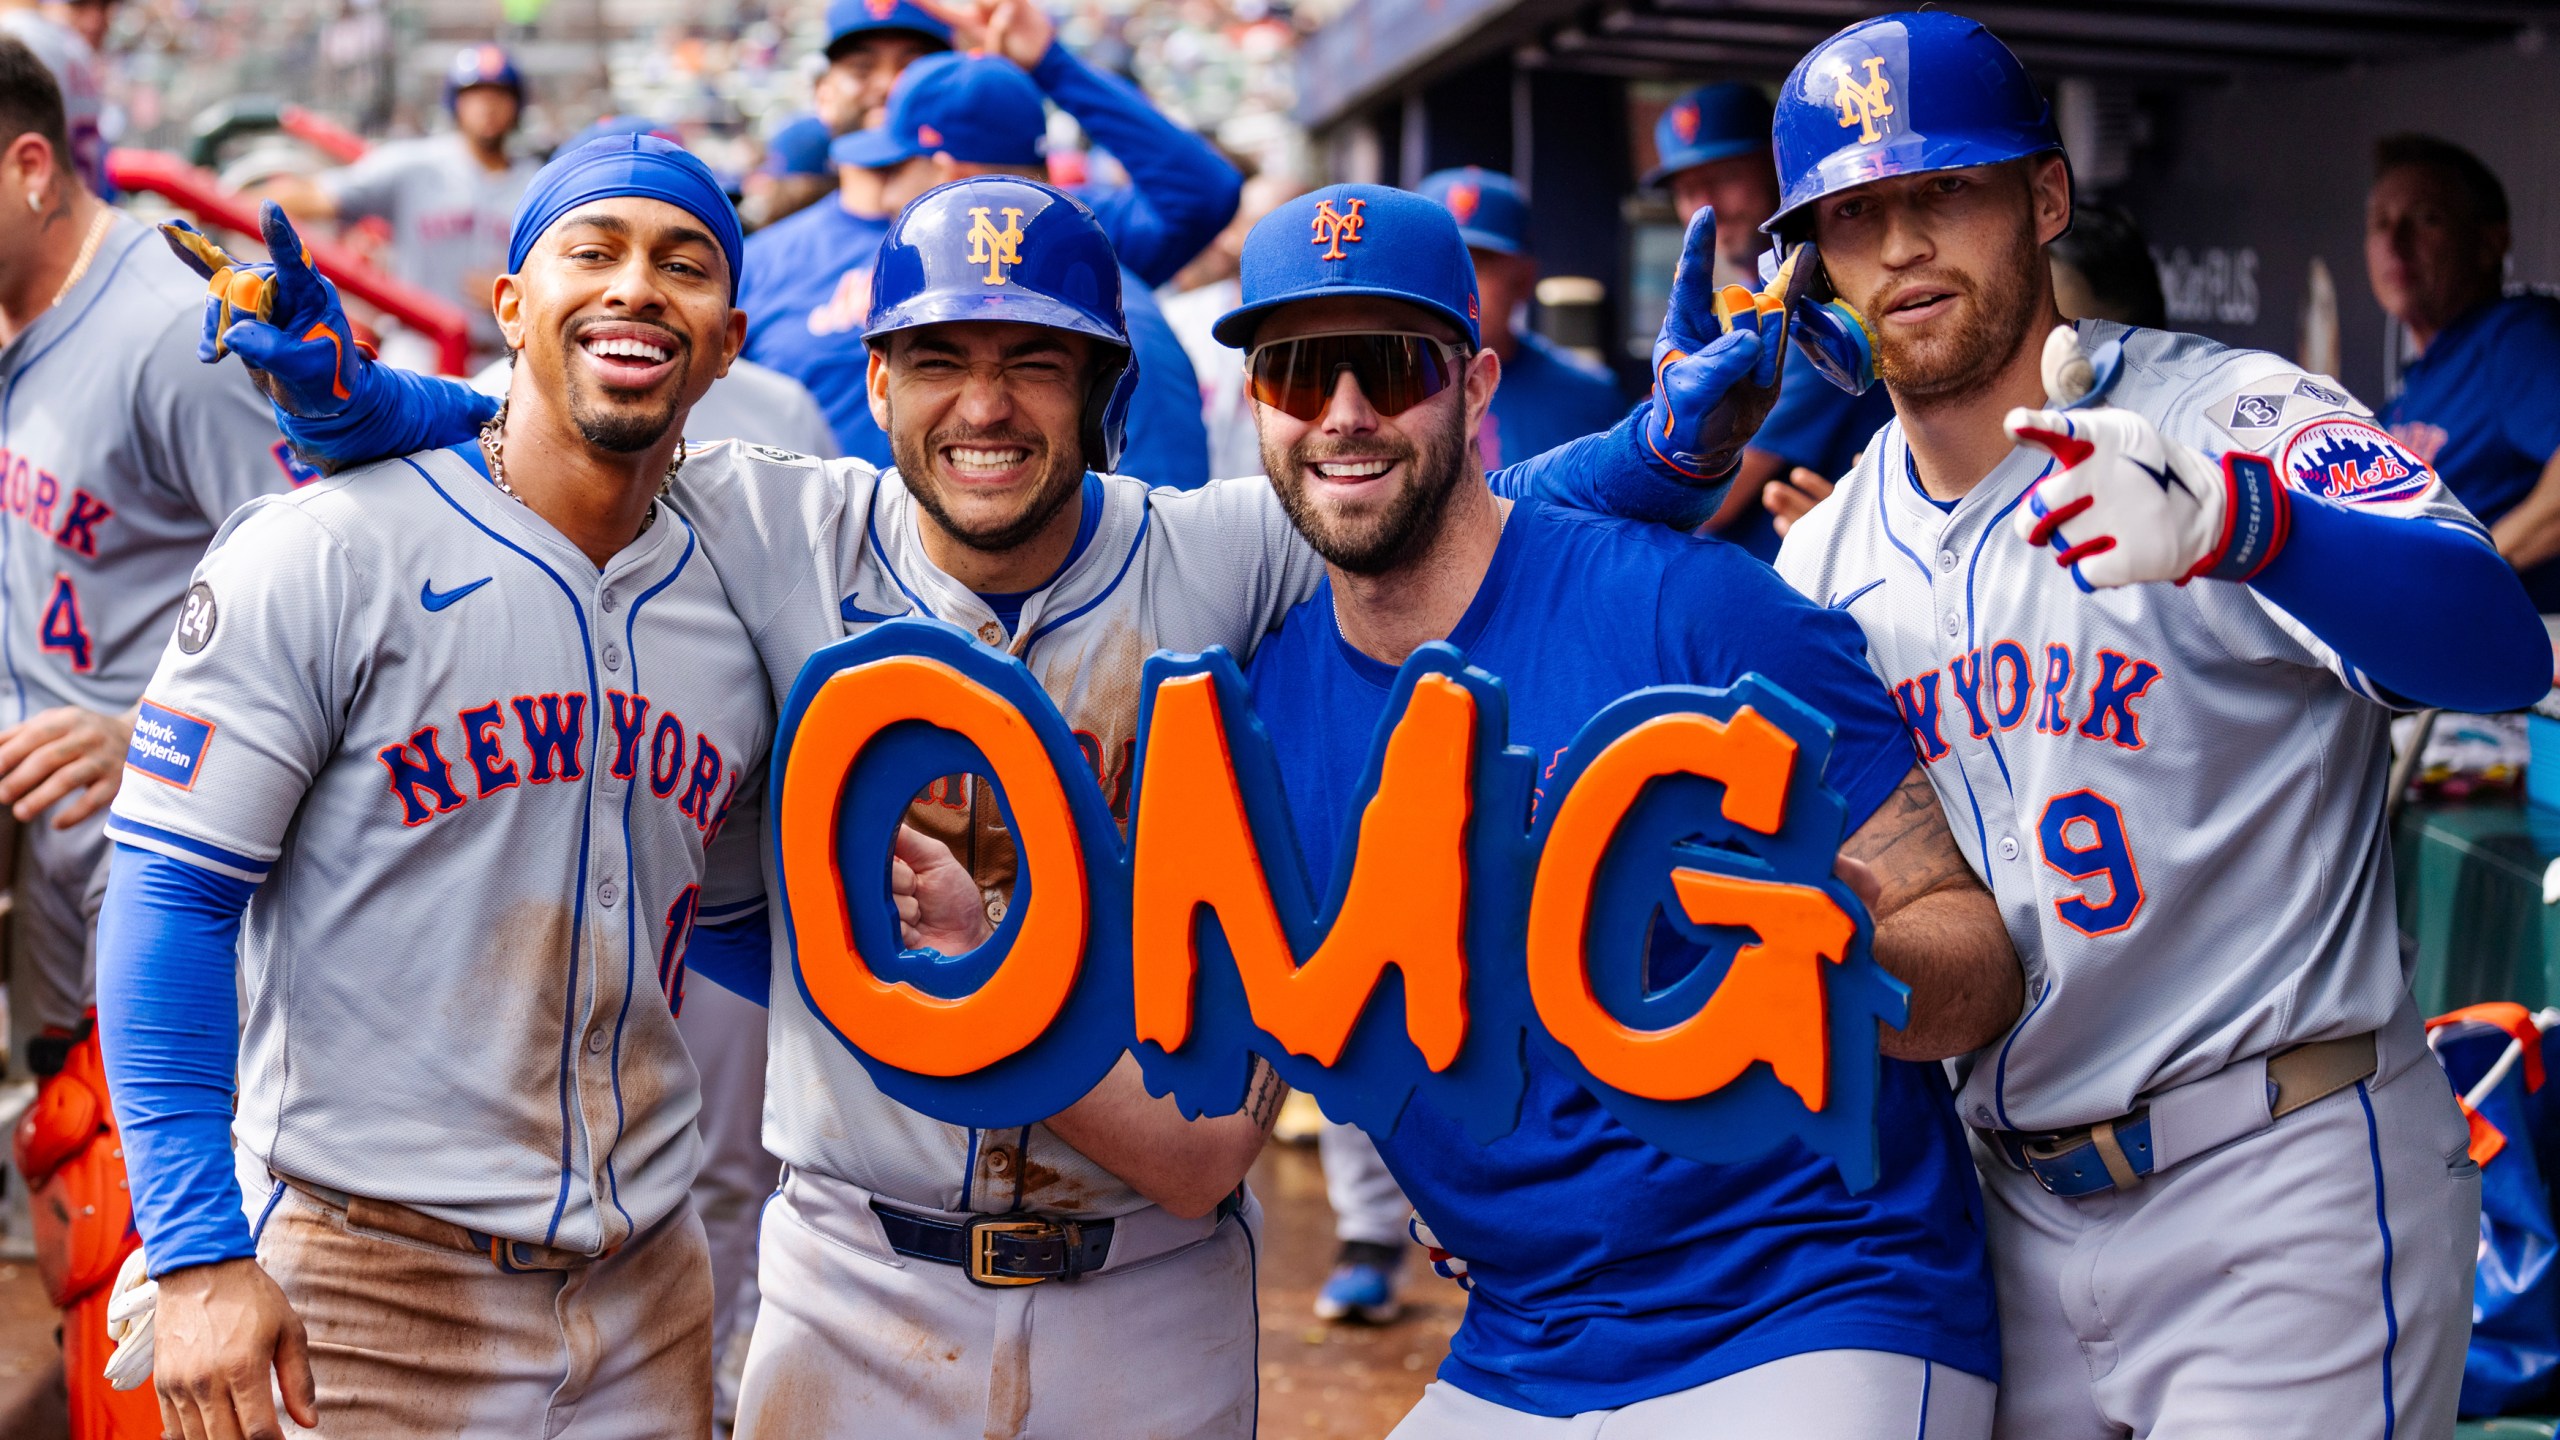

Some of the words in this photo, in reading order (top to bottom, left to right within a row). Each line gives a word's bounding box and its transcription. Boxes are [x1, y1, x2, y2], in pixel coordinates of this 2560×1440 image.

[2323, 455, 2409, 498] Mets
[38, 571, 94, 674] 4
[181, 594, 212, 643] 24
[1948, 639, 2163, 751] YORK
[377, 691, 588, 828] NEW
[780, 653, 1857, 1113] OMG
[2034, 787, 2146, 939] 9
